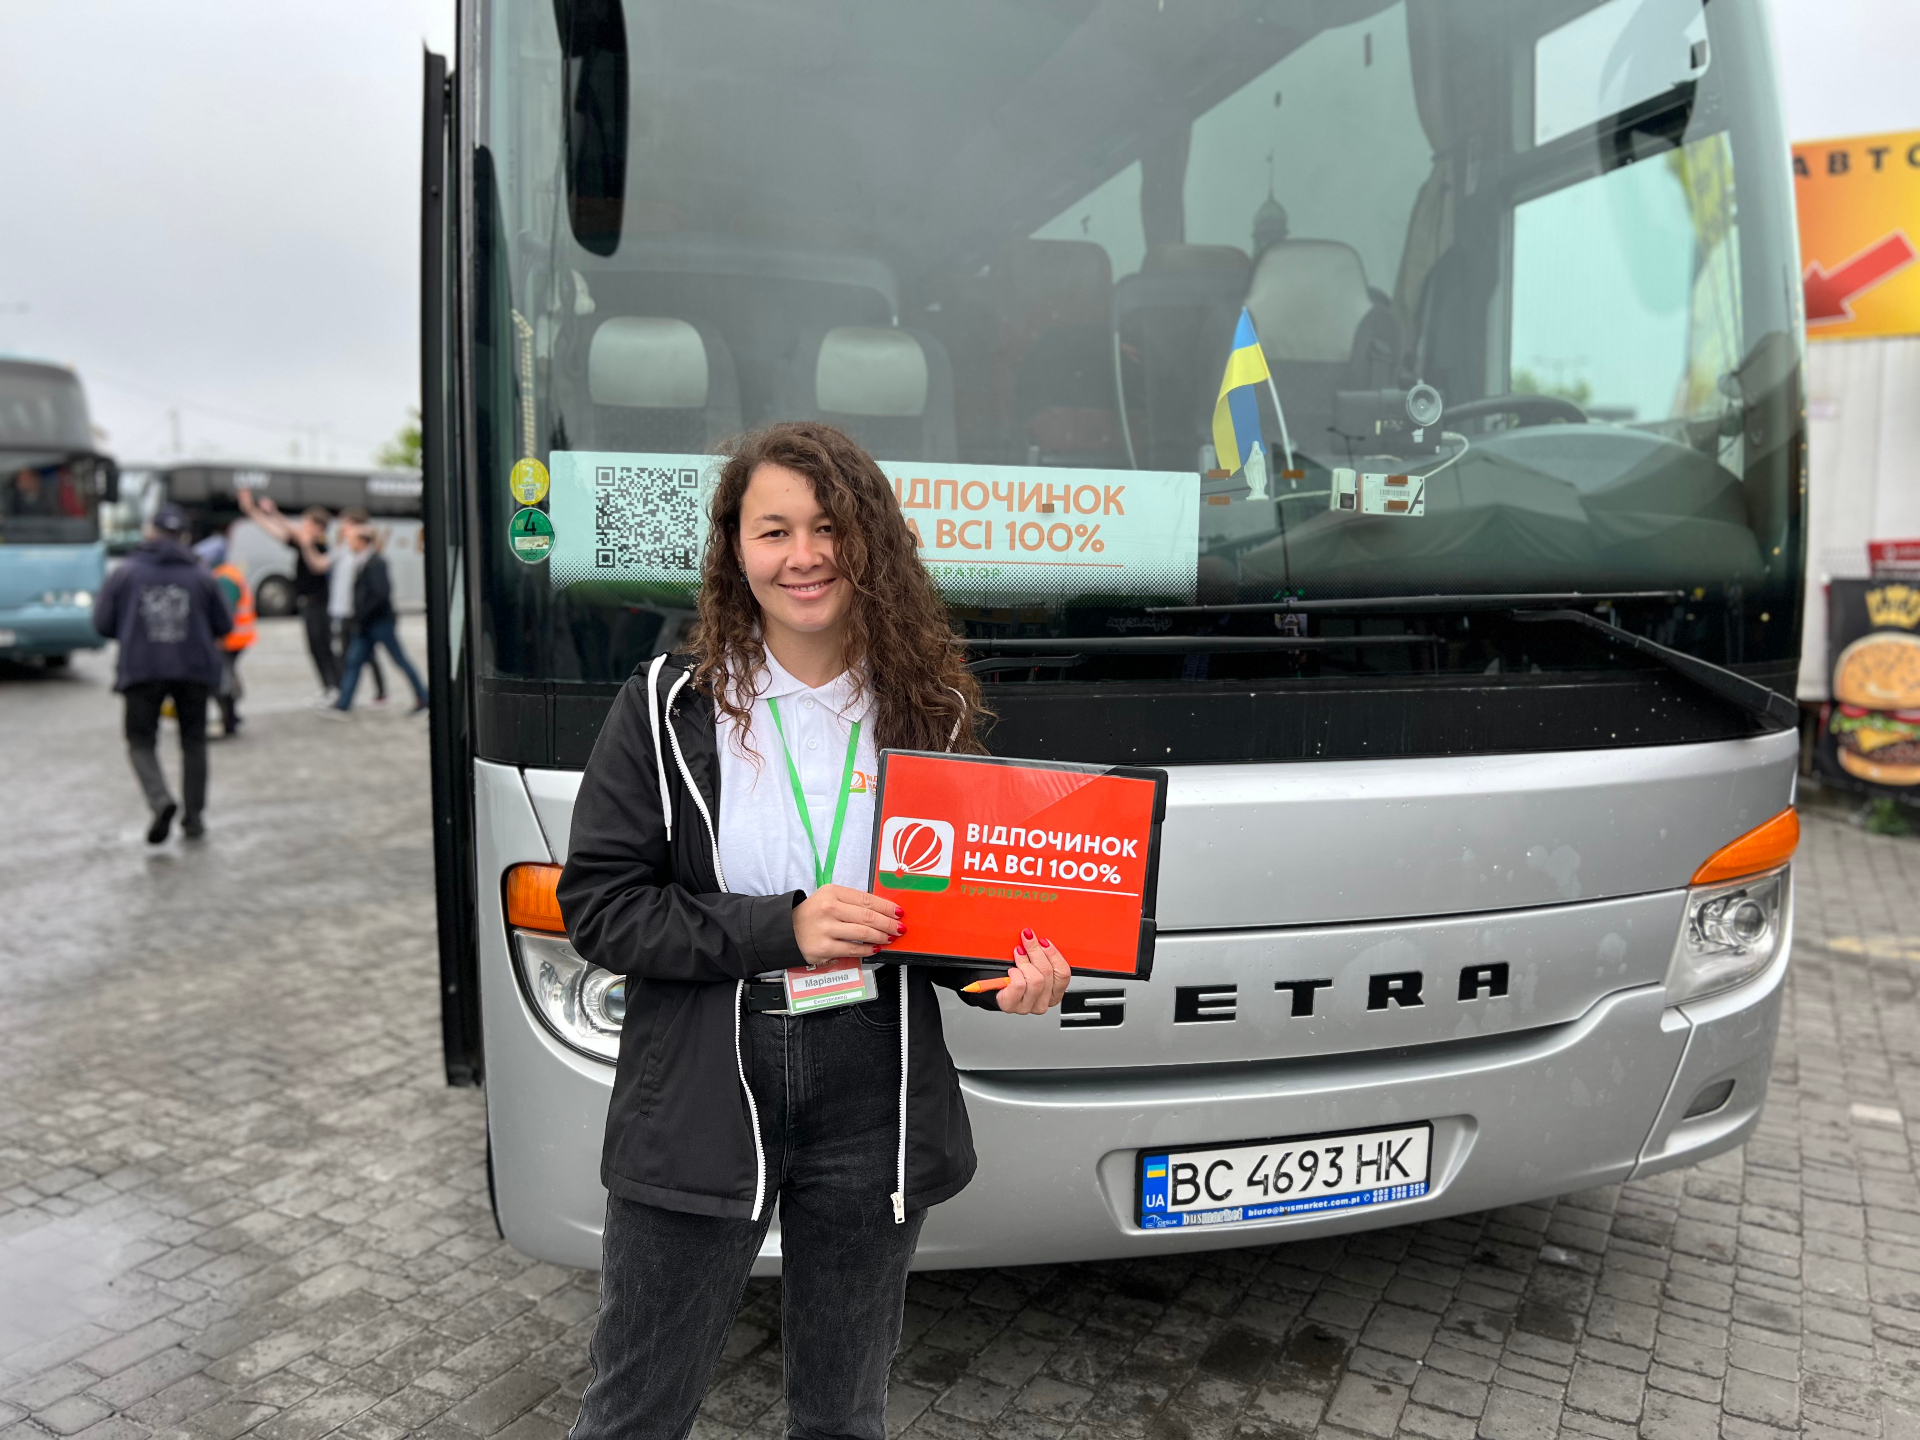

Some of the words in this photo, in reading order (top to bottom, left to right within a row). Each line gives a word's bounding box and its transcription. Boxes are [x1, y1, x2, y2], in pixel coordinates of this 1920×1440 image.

[894, 478, 1126, 516] ІДПОЧИНОК
[524, 511, 537, 536] 4
[936, 519, 992, 550] ВСІ
[1005, 520, 1105, 553] 100%
[966, 823, 1138, 858] ВІДПОЧИНОК
[963, 851, 999, 873] НА
[1005, 855, 1043, 877] ВСІ
[1049, 859, 1122, 885] 100%
[960, 884, 1058, 902] ТУРОПЕРАТОР
[805, 973, 849, 988] Маріанна
[1060, 962, 1509, 1030] SETRA
[1171, 1159, 1234, 1206] BC
[1247, 1146, 1344, 1196] 4693
[1356, 1137, 1413, 1184] HK
[1146, 1194, 1165, 1207] UA
[1248, 1196, 1360, 1217] biuro@busmarket.com.pl
[1183, 1207, 1243, 1225] busmarket
